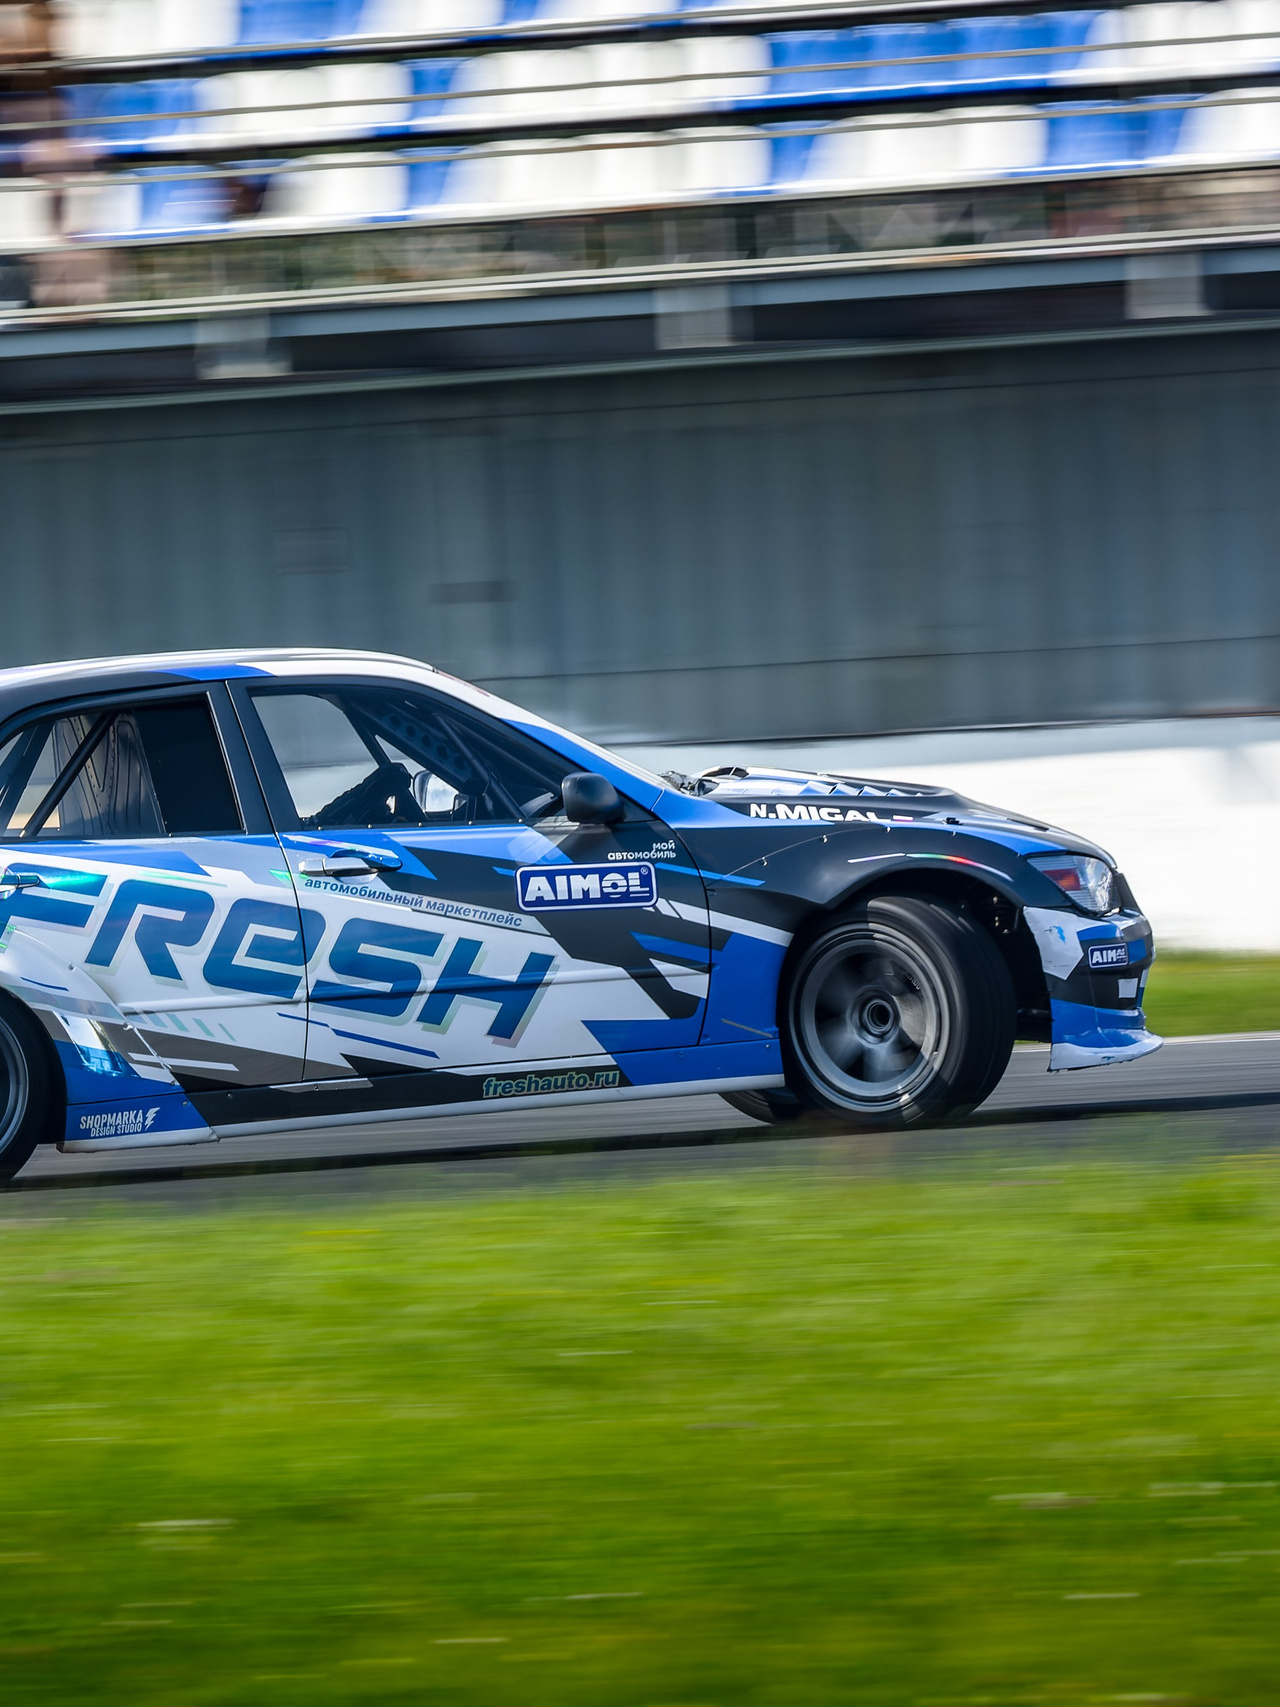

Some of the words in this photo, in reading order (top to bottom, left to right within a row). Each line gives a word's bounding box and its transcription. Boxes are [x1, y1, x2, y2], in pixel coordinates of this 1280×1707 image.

[652, 840, 676, 850] мой
[607, 850, 676, 861] автомобиль
[524, 870, 650, 902] AIMOL
[304, 877, 424, 908] автомобильный
[425, 900, 523, 927] маркетплейс
[483, 1070, 620, 1098] freshauto.ru
[80, 1109, 143, 1129] SHOPMARKA
[90, 1125, 115, 1137] DESIGN
[116, 1122, 143, 1134] STUDIO
